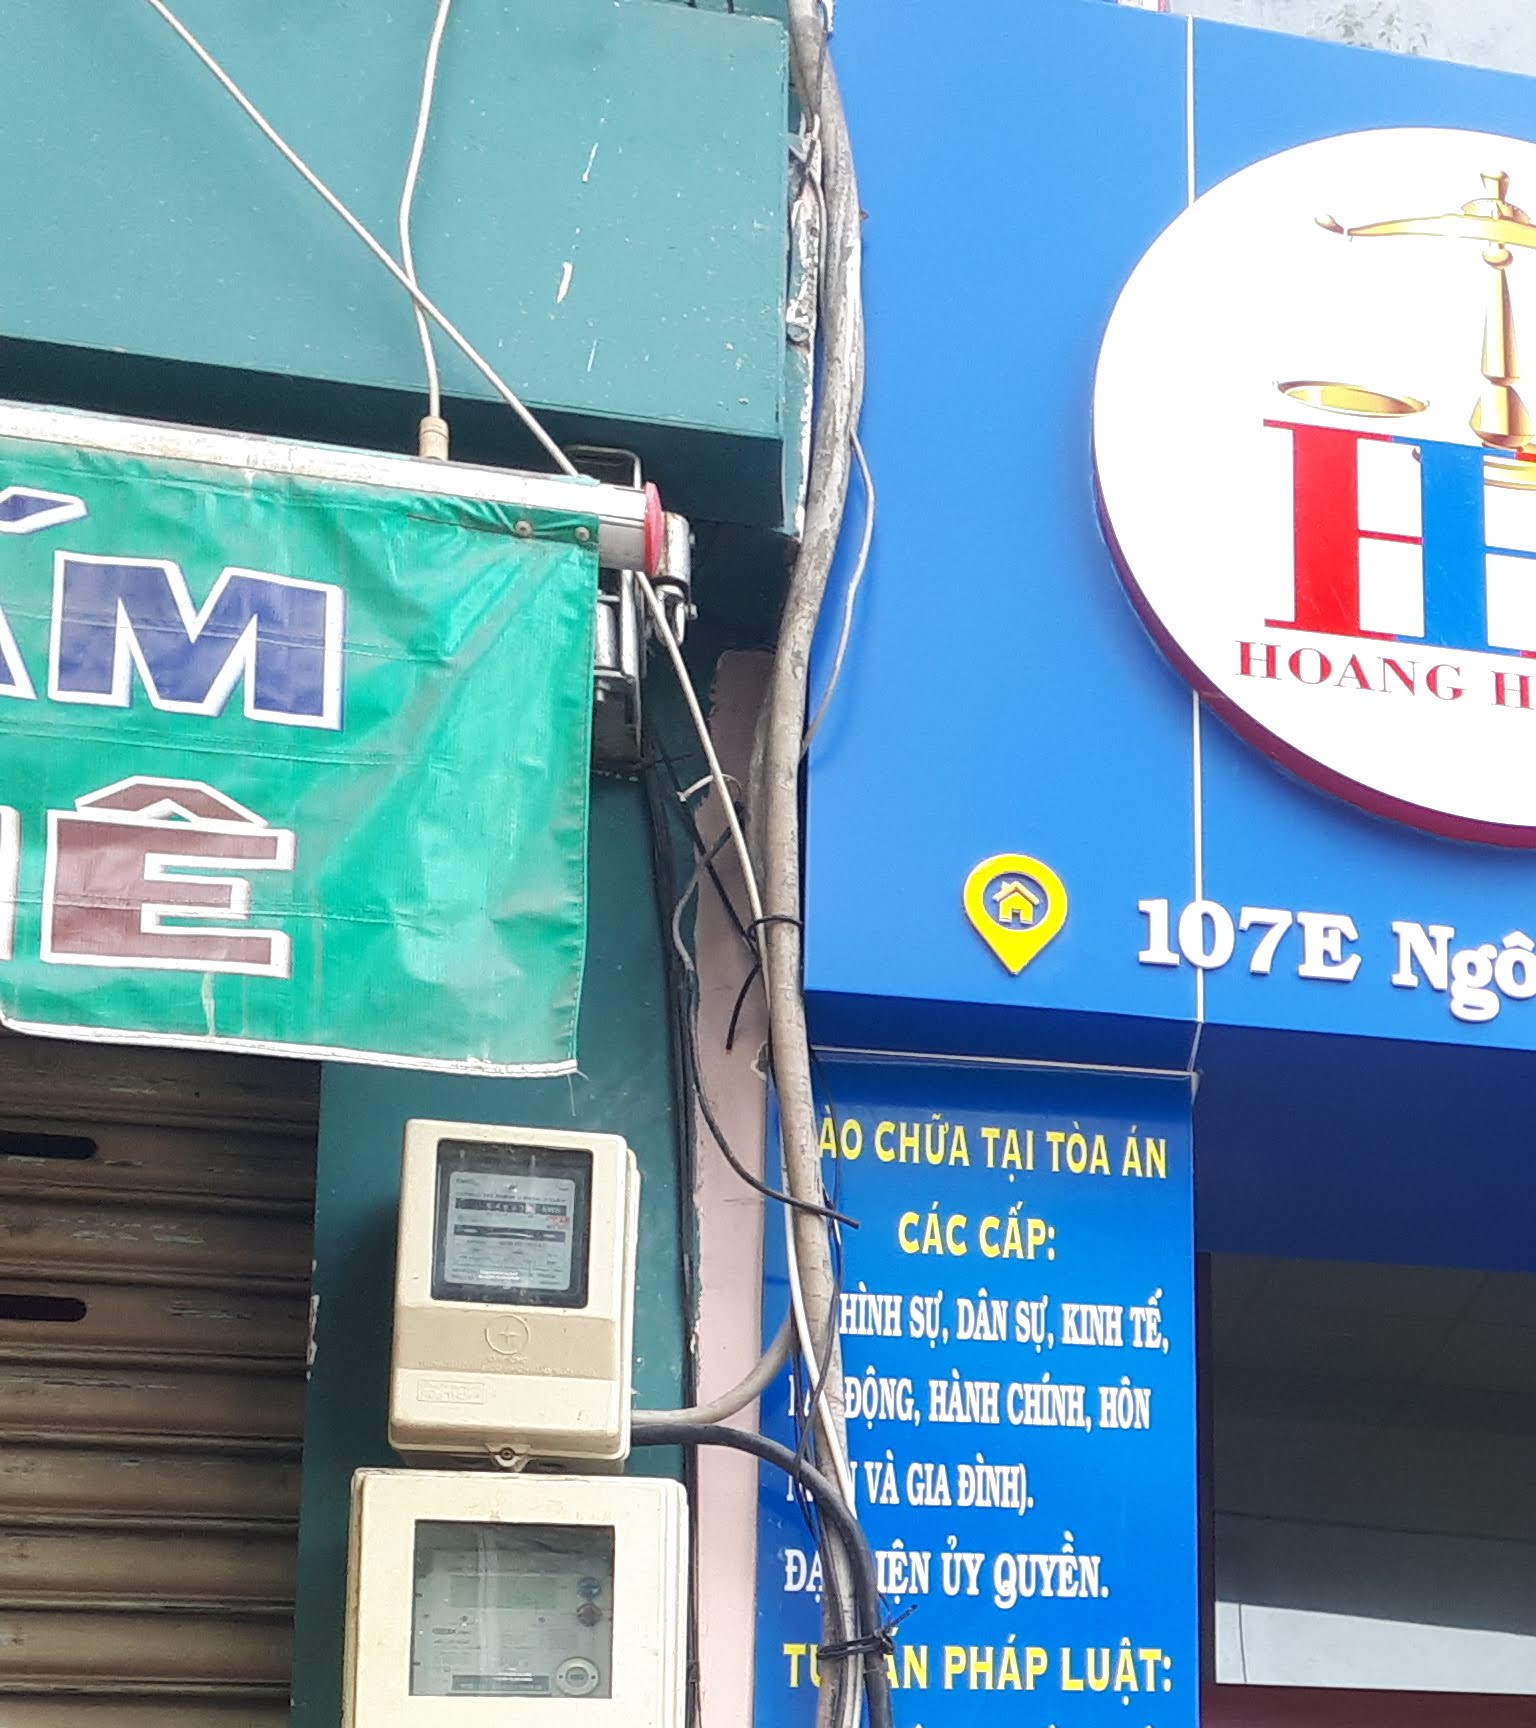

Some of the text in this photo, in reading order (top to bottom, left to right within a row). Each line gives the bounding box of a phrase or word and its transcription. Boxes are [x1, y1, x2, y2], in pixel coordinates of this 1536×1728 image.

[0, 486, 345, 731] M
[1236, 640, 1464, 701] HOANG
[1137, 898, 1361, 983] 107E
[874, 1113, 1167, 1183] CHỮA TẠI TÒA ÁN
[898, 1201, 1055, 1261] CÁC CẤP:
[909, 1290, 949, 1349] SỰ,
[956, 1287, 1009, 1341] DÂN
[1015, 1295, 1054, 1353] SỰ,
[1061, 1303, 1124, 1347] KINH
[1129, 1288, 1169, 1354] TẾ,
[928, 1368, 1000, 1424] HÀNH
[1006, 1372, 1092, 1432] CHÍNH,
[1098, 1376, 1151, 1430] HÔN
[863, 1449, 900, 1505] VÀ
[906, 1462, 952, 1506] GIA
[957, 1452, 1034, 1516] ĐÌNH).
[940, 1530, 1109, 1609] ỦY QUYỀN.
[944, 1633, 1172, 1706] PHÁP LUẬT:
